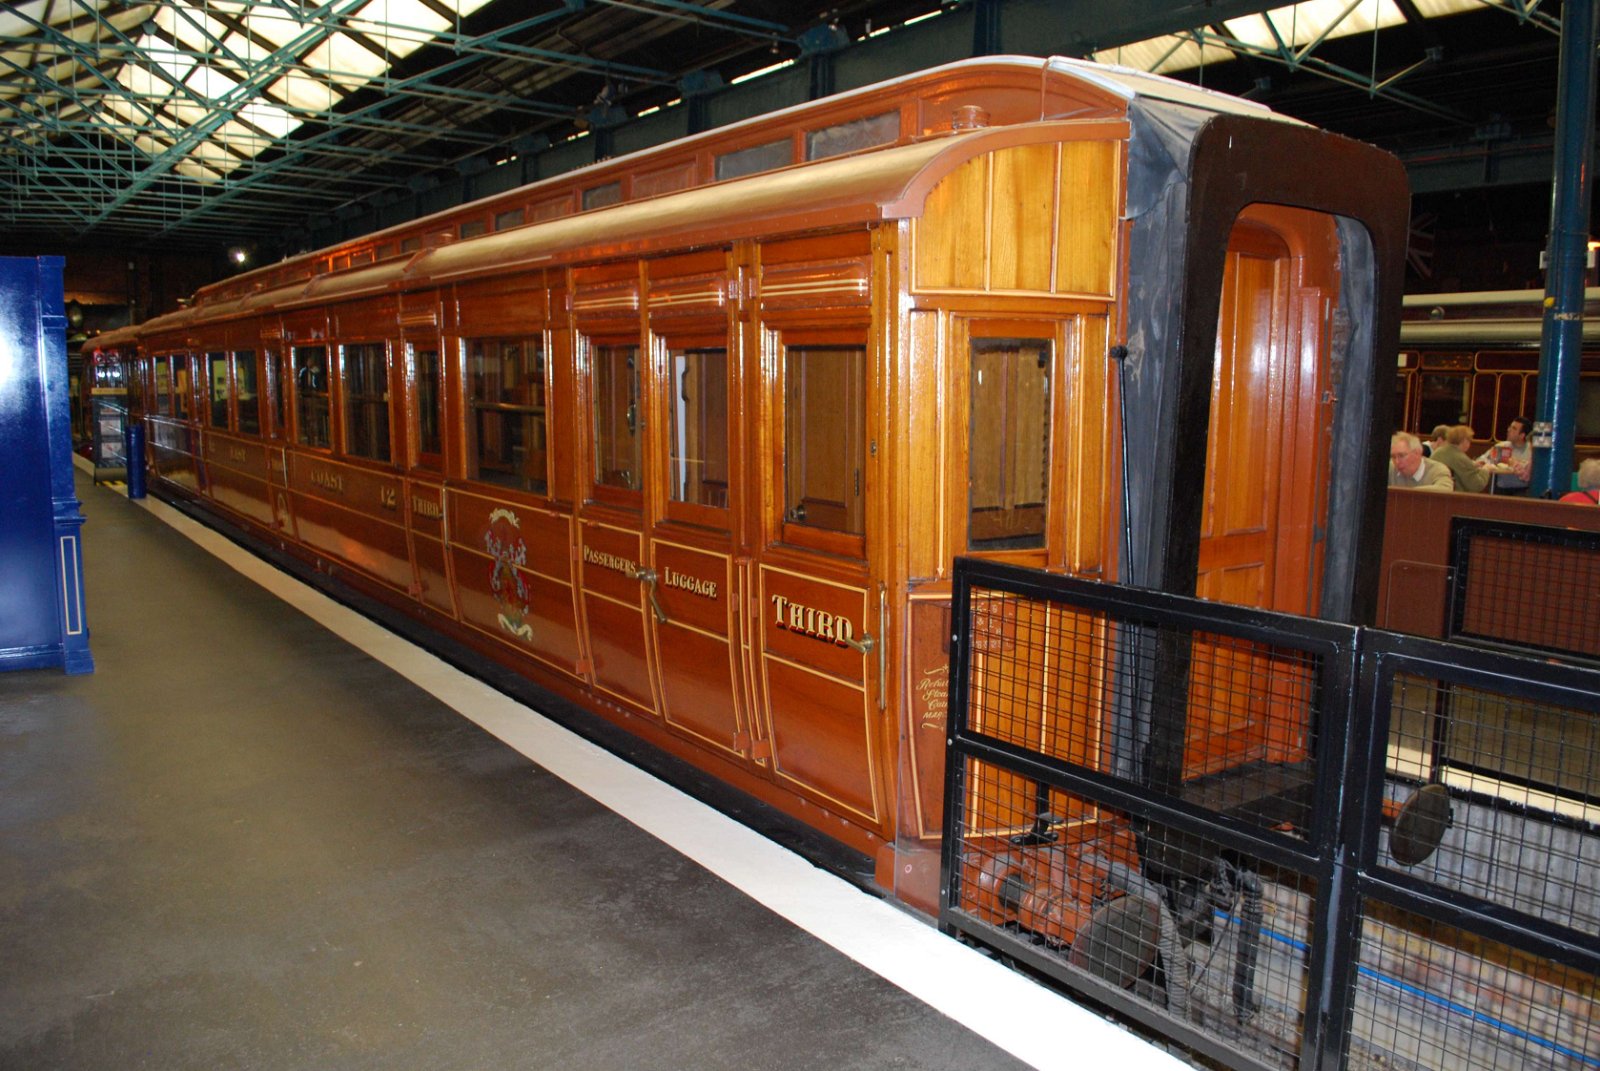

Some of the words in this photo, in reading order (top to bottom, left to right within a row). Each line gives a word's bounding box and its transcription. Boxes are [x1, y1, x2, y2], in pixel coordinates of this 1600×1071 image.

[310, 470, 344, 492] COAST
[380, 485, 396, 507] 12
[412, 495, 440, 519] THIRD
[663, 566, 718, 599] LUGGAGE
[771, 594, 853, 646] THIRD
